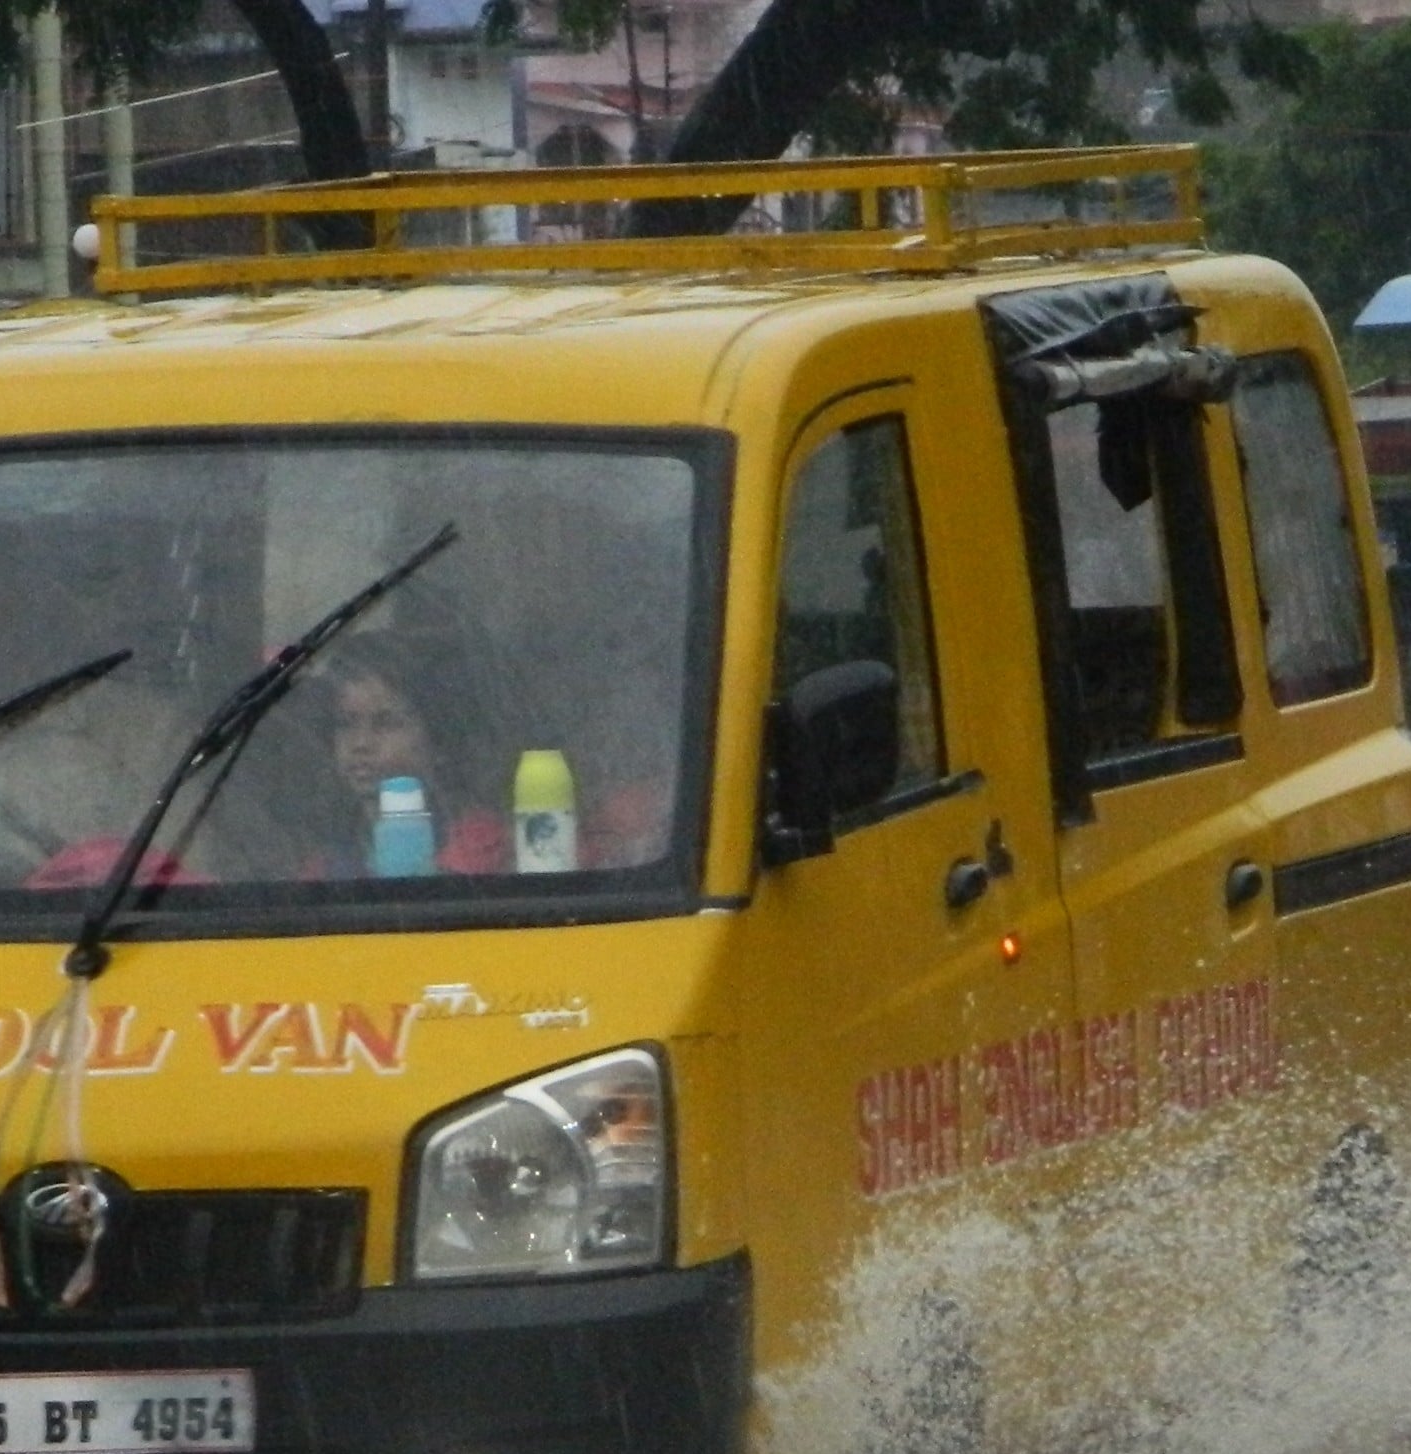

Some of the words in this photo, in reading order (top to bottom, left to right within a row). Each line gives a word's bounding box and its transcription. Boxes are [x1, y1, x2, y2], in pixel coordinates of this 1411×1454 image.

[198, 1001, 420, 1075] VAN
[44, 1400, 99, 1444] BT
[132, 1397, 236, 1442] 4954
